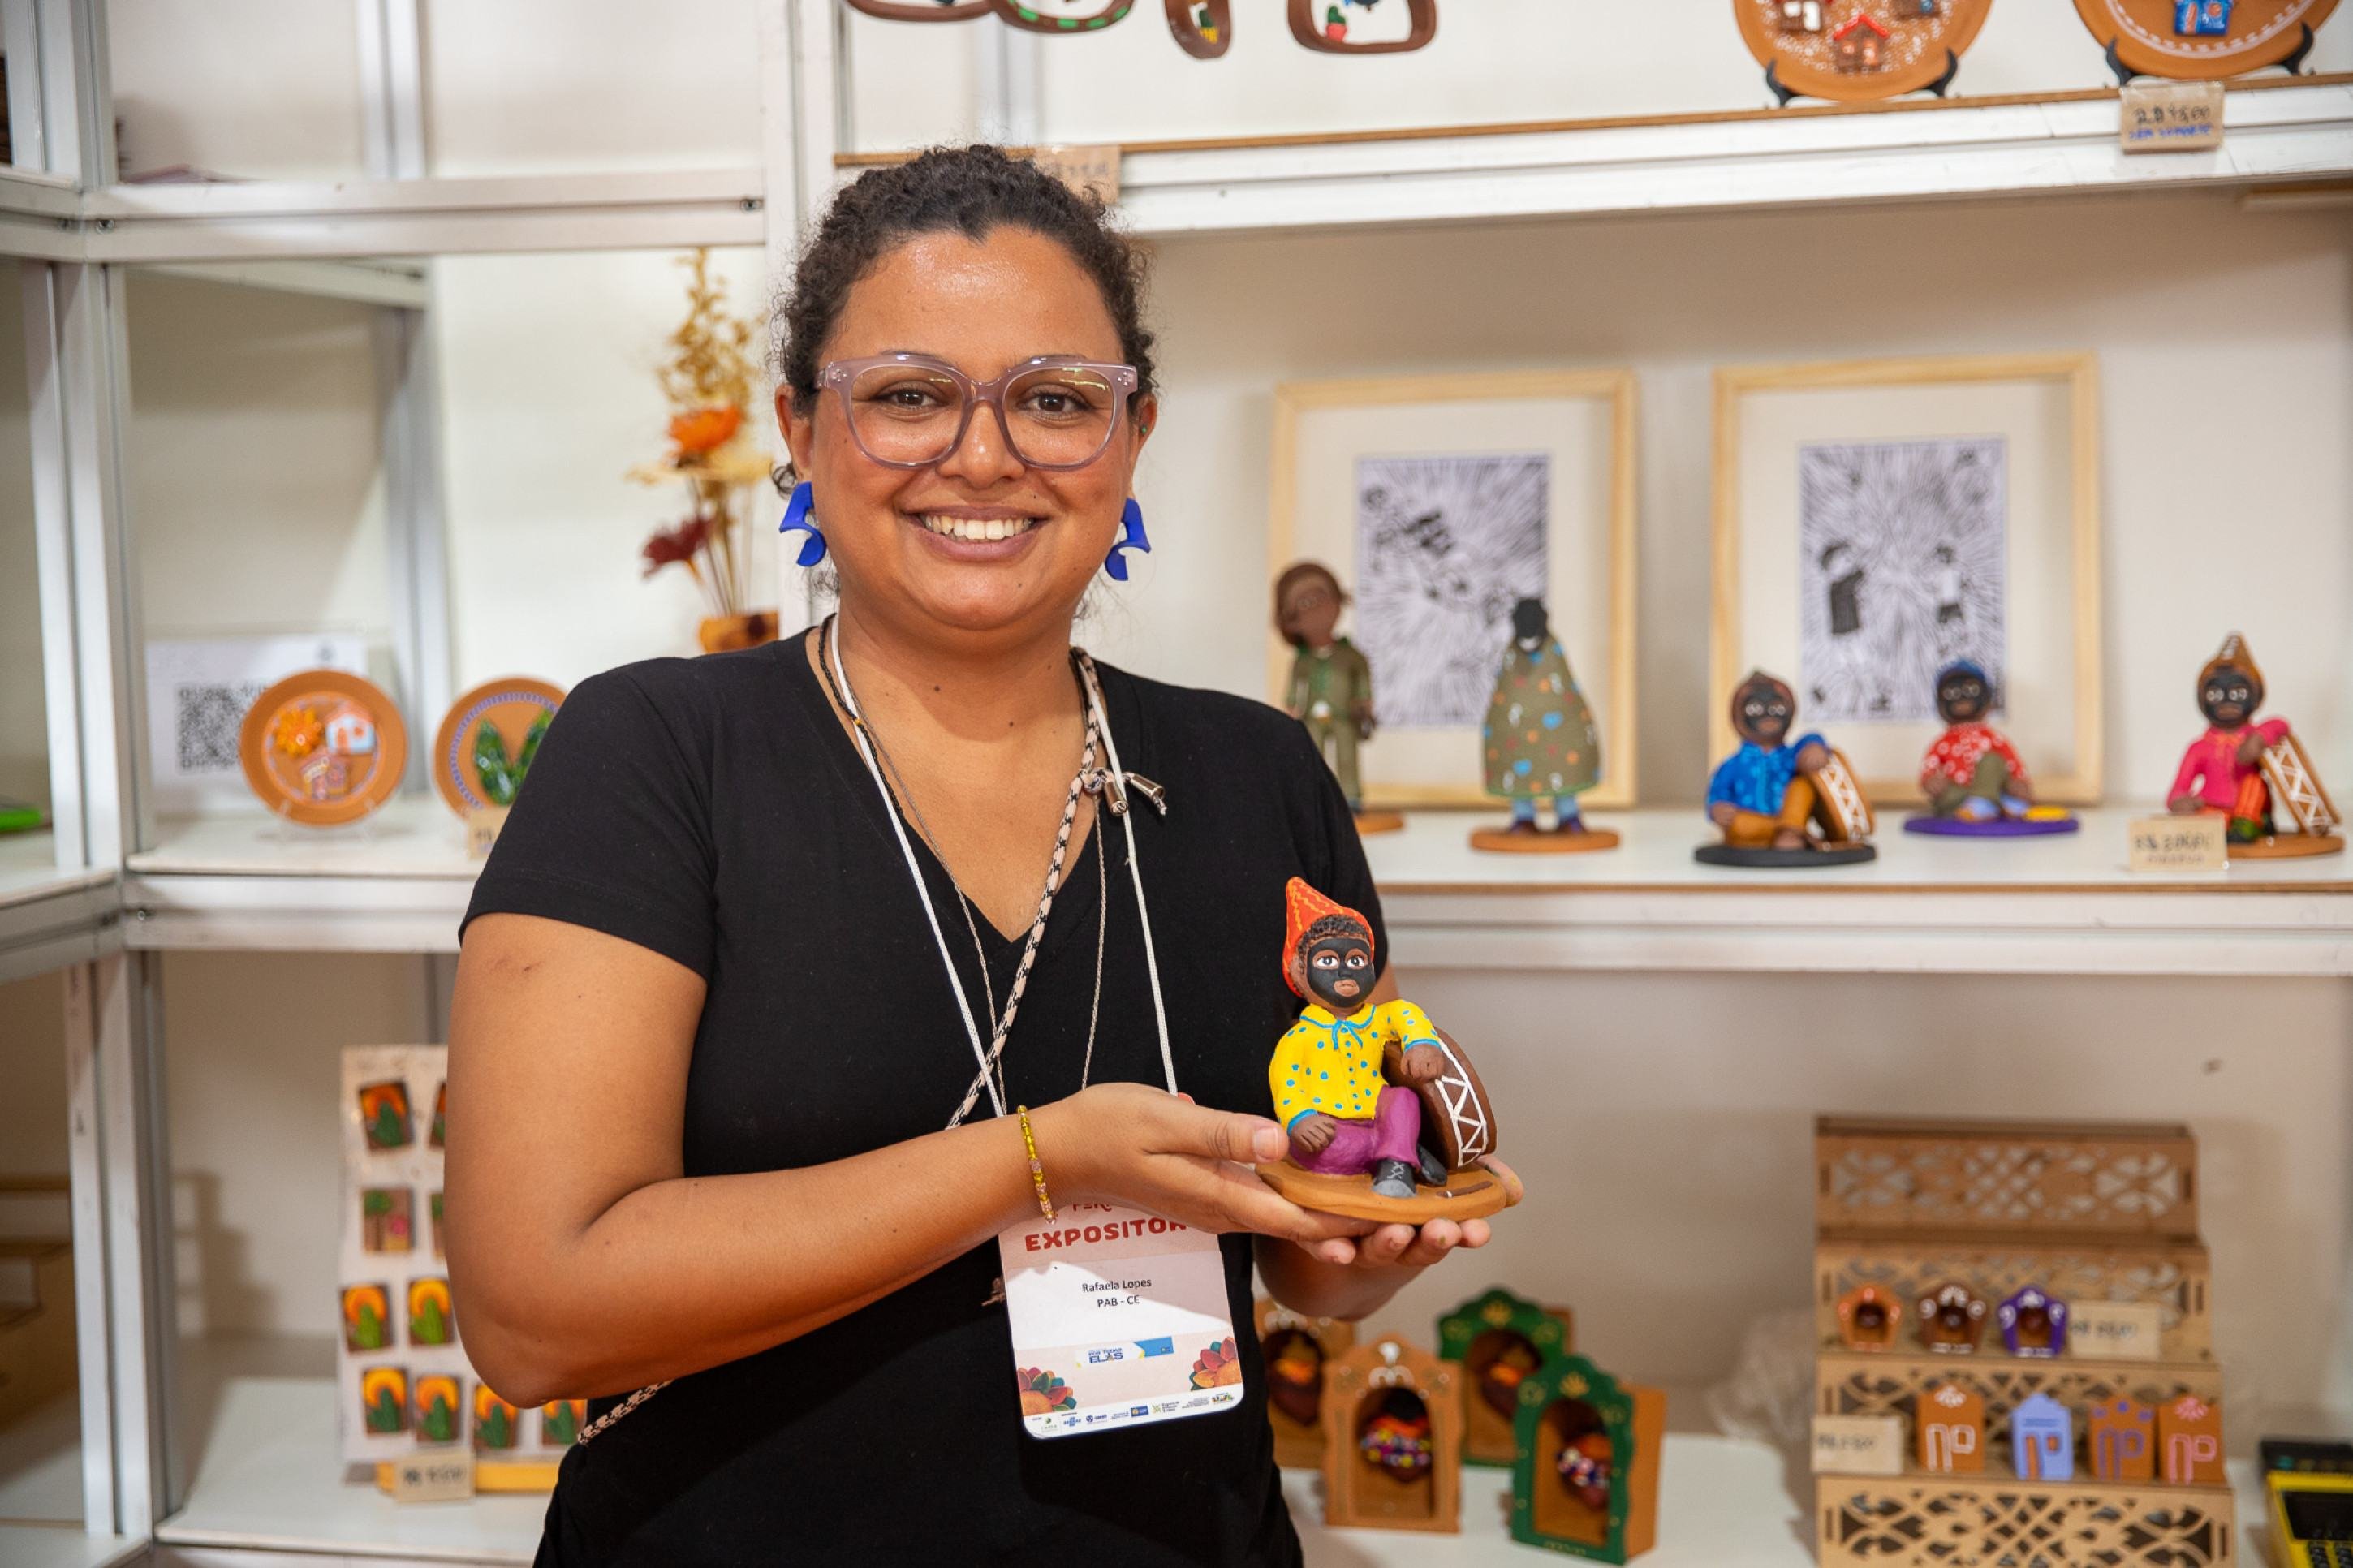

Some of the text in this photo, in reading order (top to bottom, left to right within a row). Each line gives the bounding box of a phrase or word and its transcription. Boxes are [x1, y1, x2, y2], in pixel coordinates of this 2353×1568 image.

[1082, 1279, 1152, 1293] Rafaela Lopes
[1097, 1297, 1118, 1308] PAB
[1127, 1294, 1140, 1305] CE
[1089, 1351, 1123, 1363] ELAS
